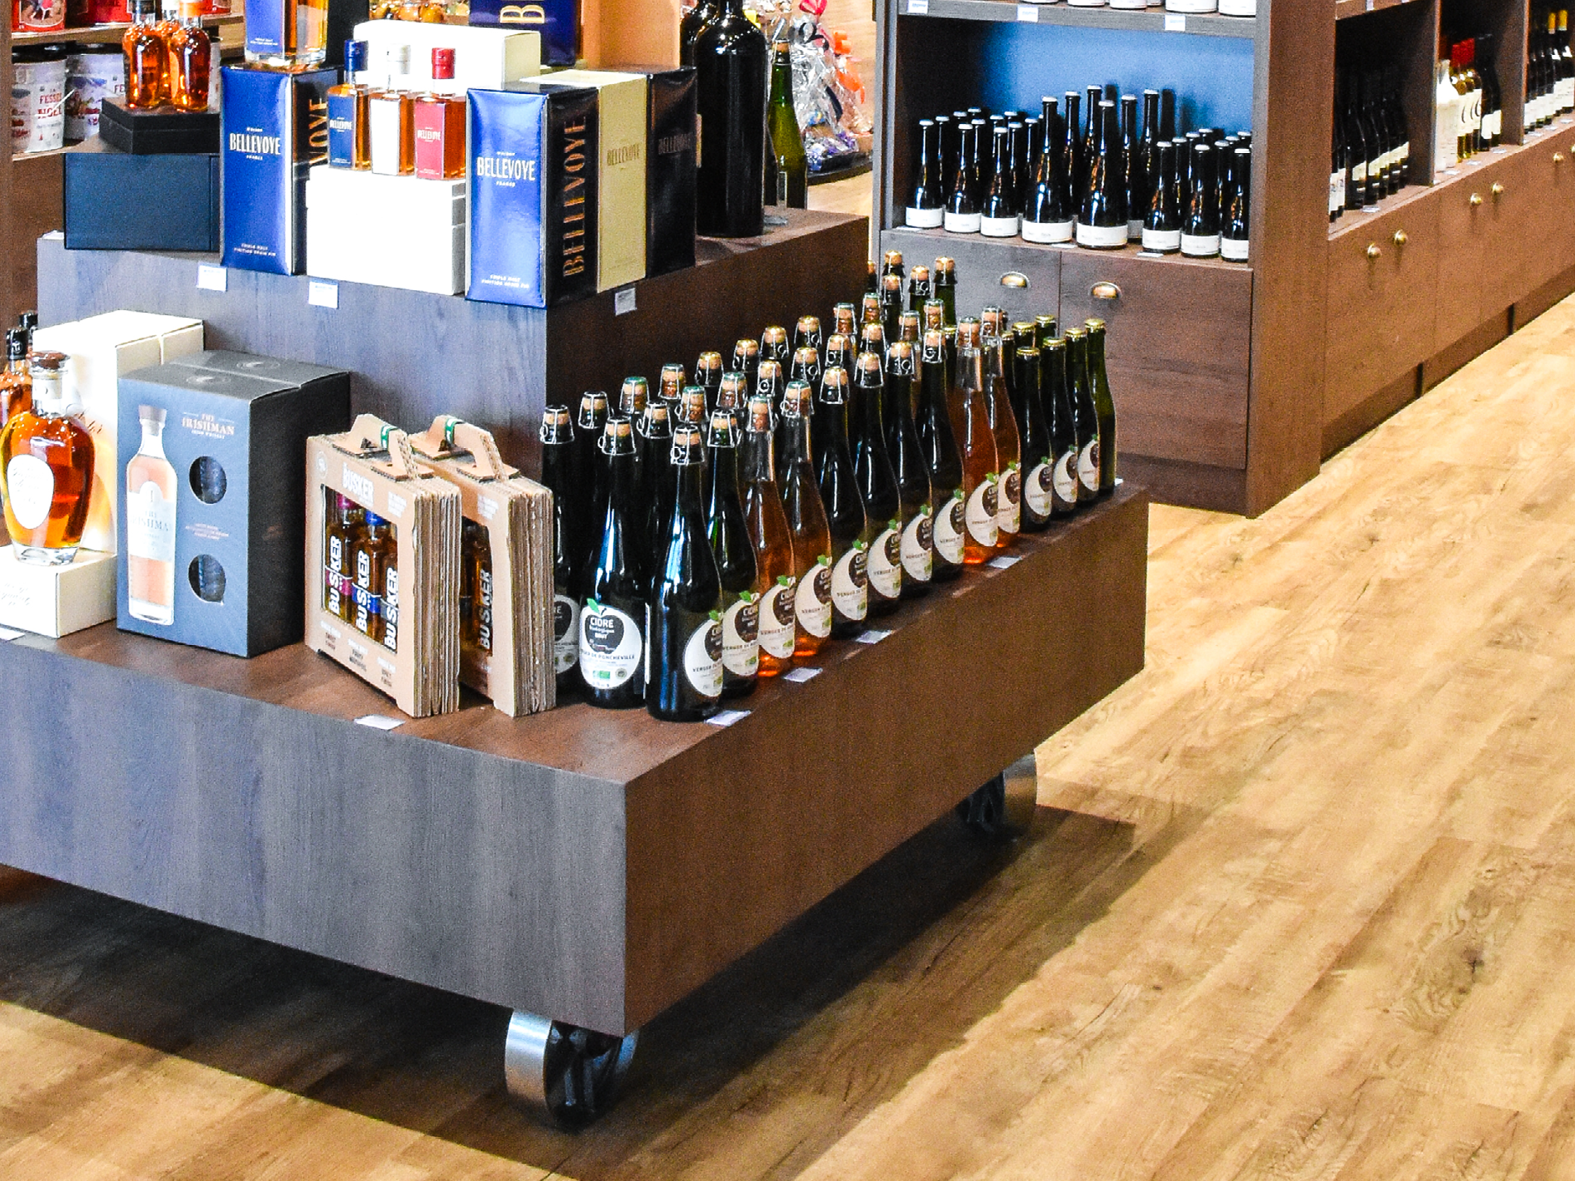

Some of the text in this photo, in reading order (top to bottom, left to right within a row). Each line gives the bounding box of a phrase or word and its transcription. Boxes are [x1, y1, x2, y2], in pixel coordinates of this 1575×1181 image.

[229, 133, 281, 156] BELLEVOYE
[606, 142, 641, 166] BELLEVOYE
[477, 156, 536, 181] BELLEVOYE
[563, 116, 586, 277] BELLEVOYE
[181, 417, 235, 436] IRISHMAN
[328, 534, 343, 616] BUSKER
[355, 549, 370, 634] BUSKER
[383, 566, 399, 651] BUSKER
[589, 616, 614, 629] CIDRE
